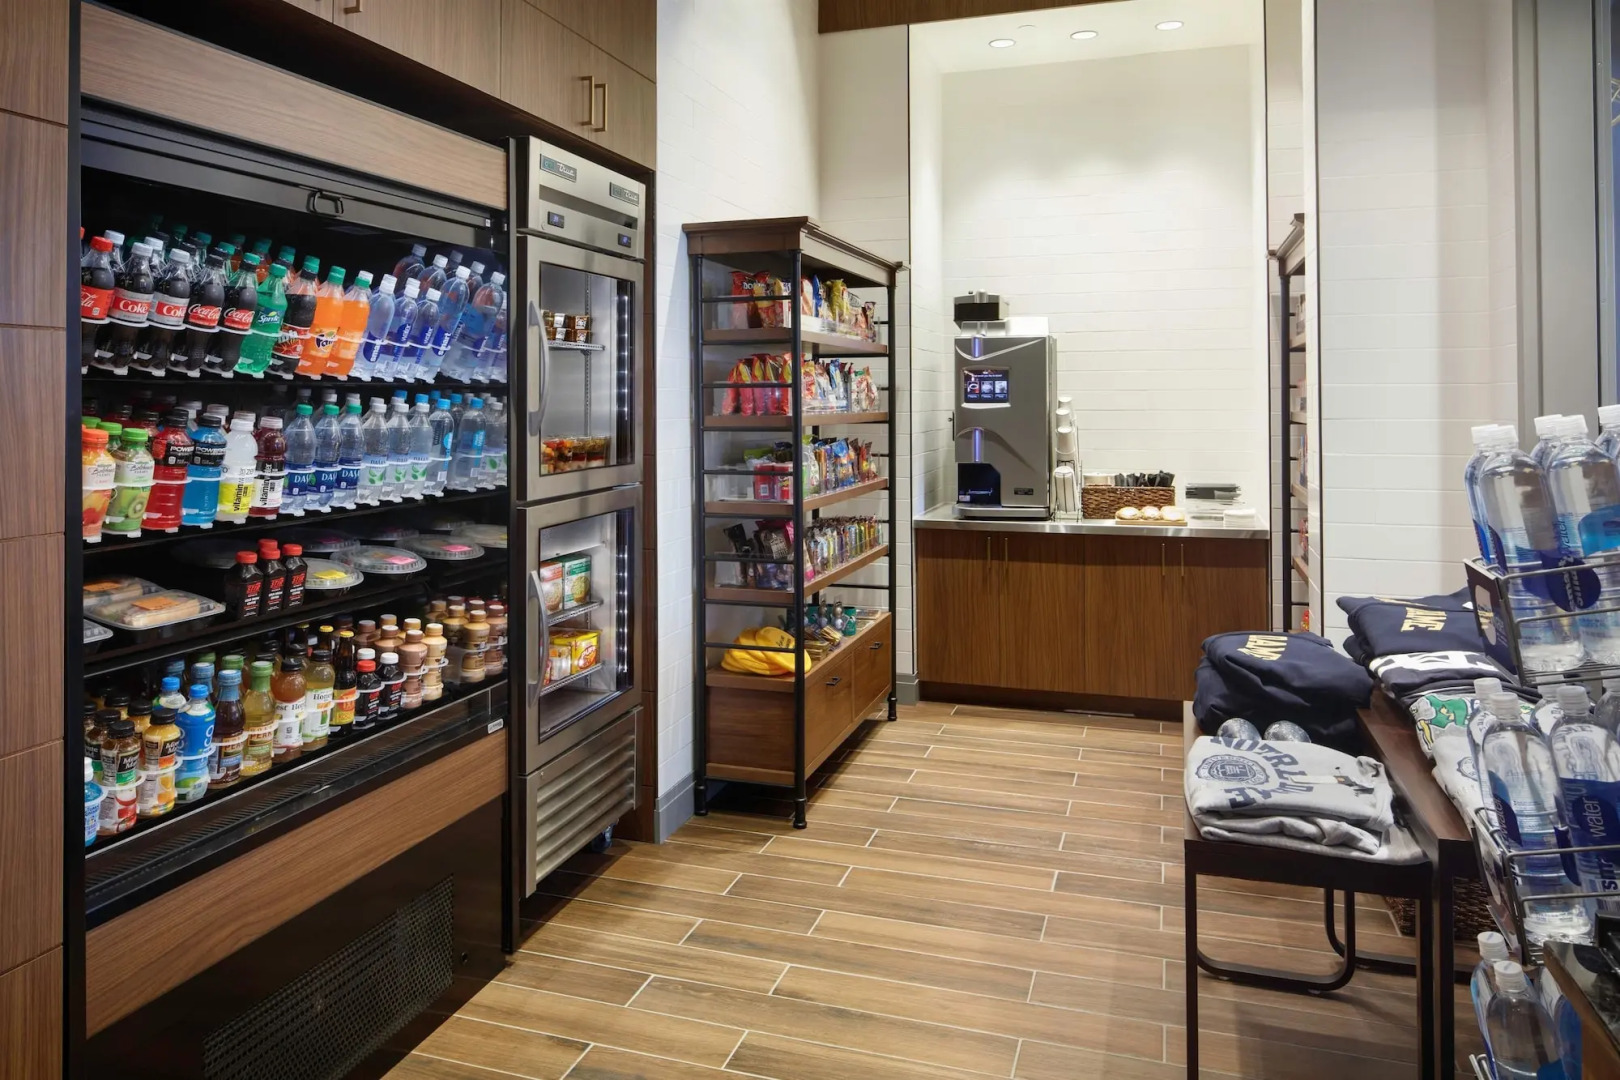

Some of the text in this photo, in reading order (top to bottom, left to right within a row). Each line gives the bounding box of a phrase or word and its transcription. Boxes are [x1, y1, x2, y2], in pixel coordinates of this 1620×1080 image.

[119, 300, 149, 314] Coke
[162, 305, 186, 317] Cok
[259, 314, 280, 324] Sprite
[1582, 796, 1607, 838] water
